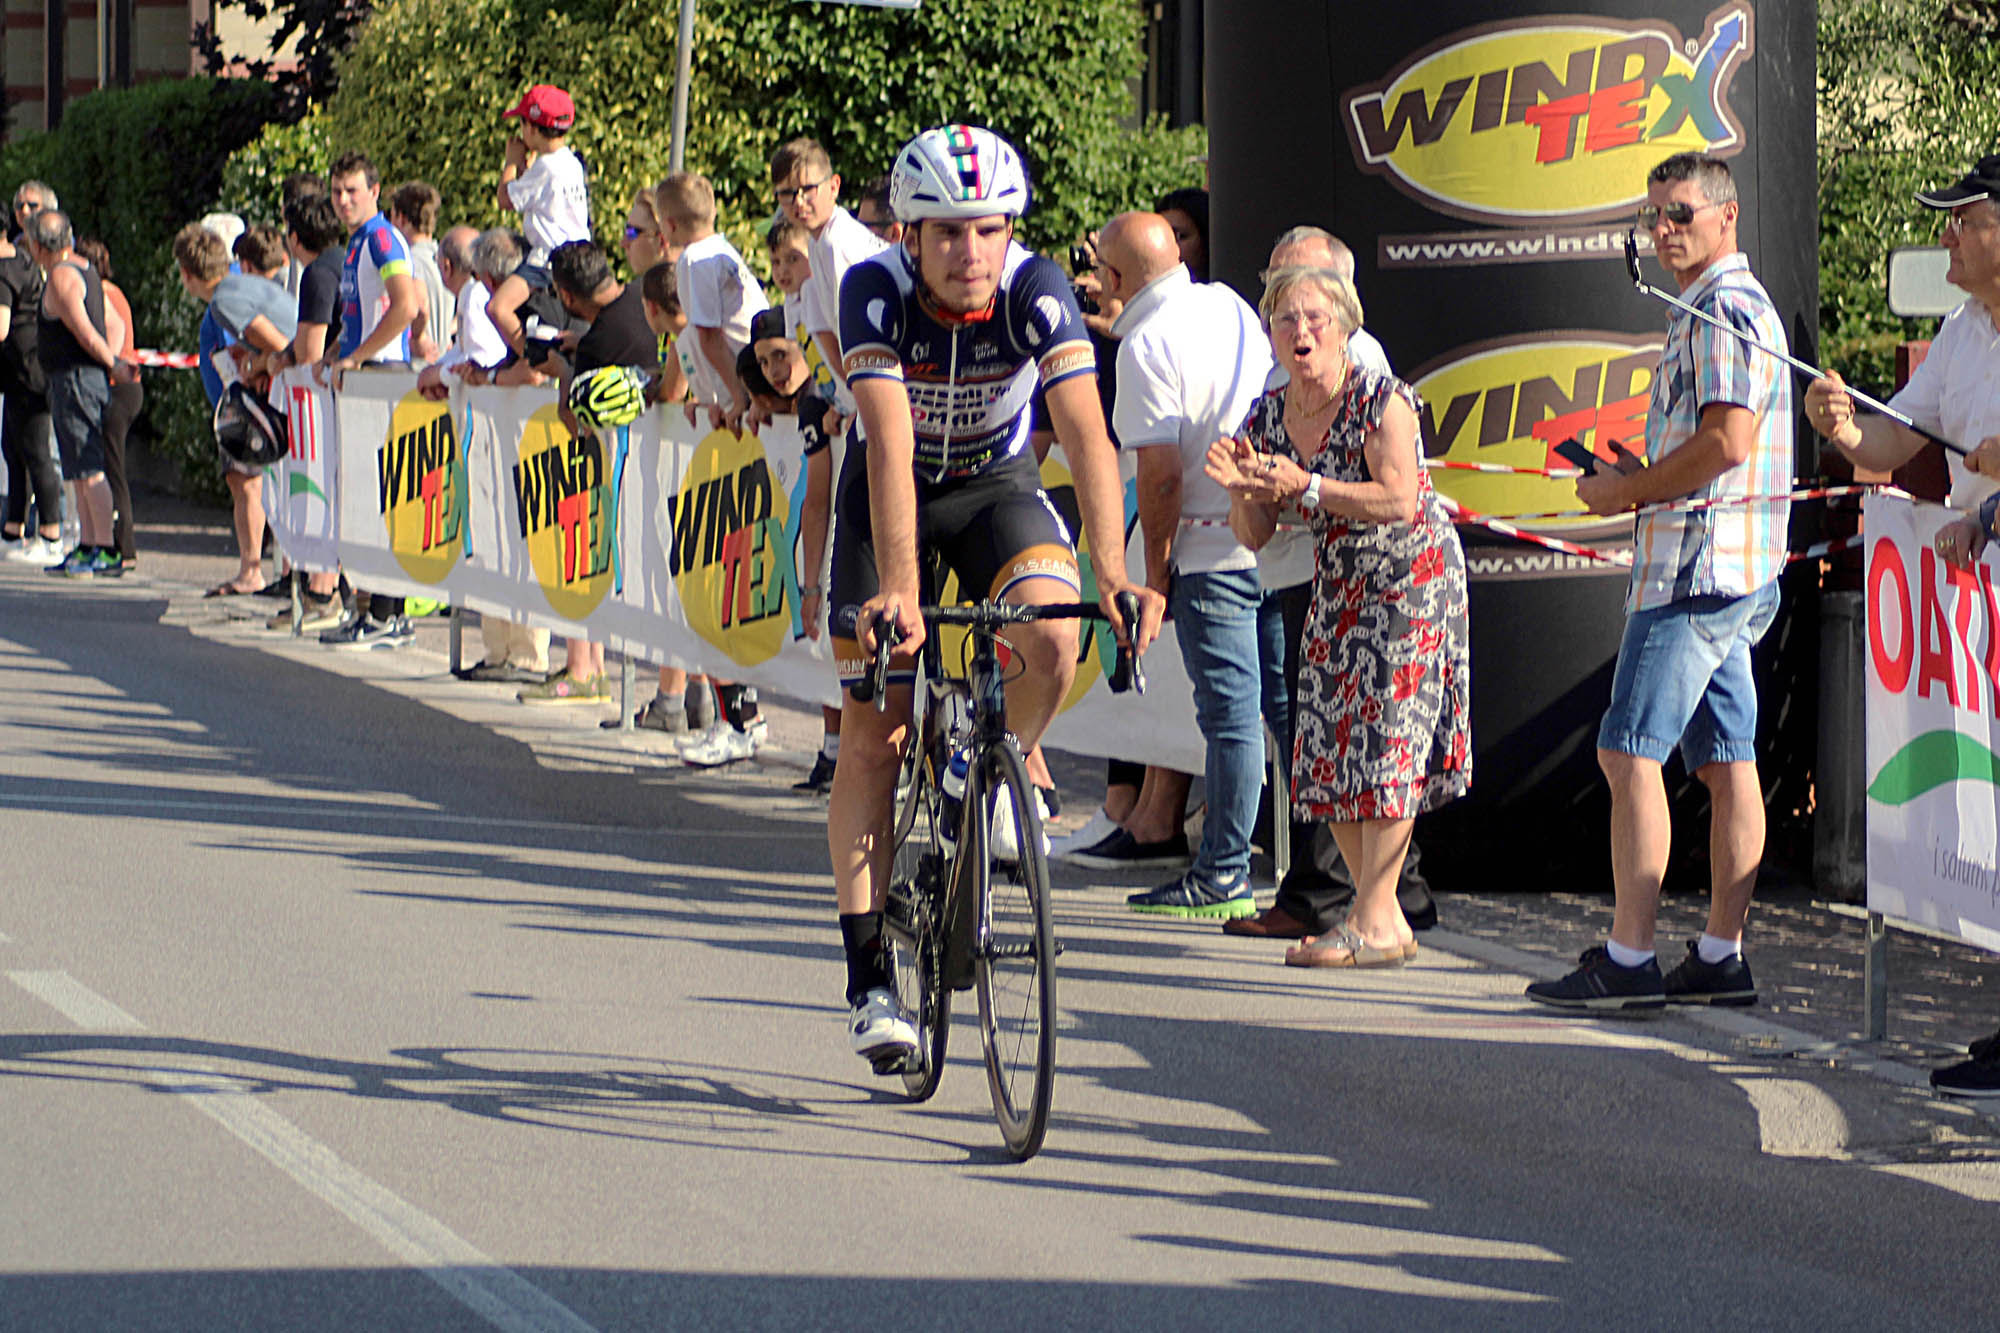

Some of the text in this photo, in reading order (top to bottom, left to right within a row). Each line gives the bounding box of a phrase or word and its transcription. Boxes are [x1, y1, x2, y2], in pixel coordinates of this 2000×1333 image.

[1354, 37, 1670, 157] WIND
[1525, 14, 1737, 165] TEX
[377, 412, 455, 514] WIND
[421, 400, 473, 558] TEX
[512, 433, 602, 539] WIND
[1532, 392, 1650, 470] TE
[667, 457, 772, 578] WIND
[722, 452, 808, 642] TEX
[1941, 841, 1990, 893] salumi
